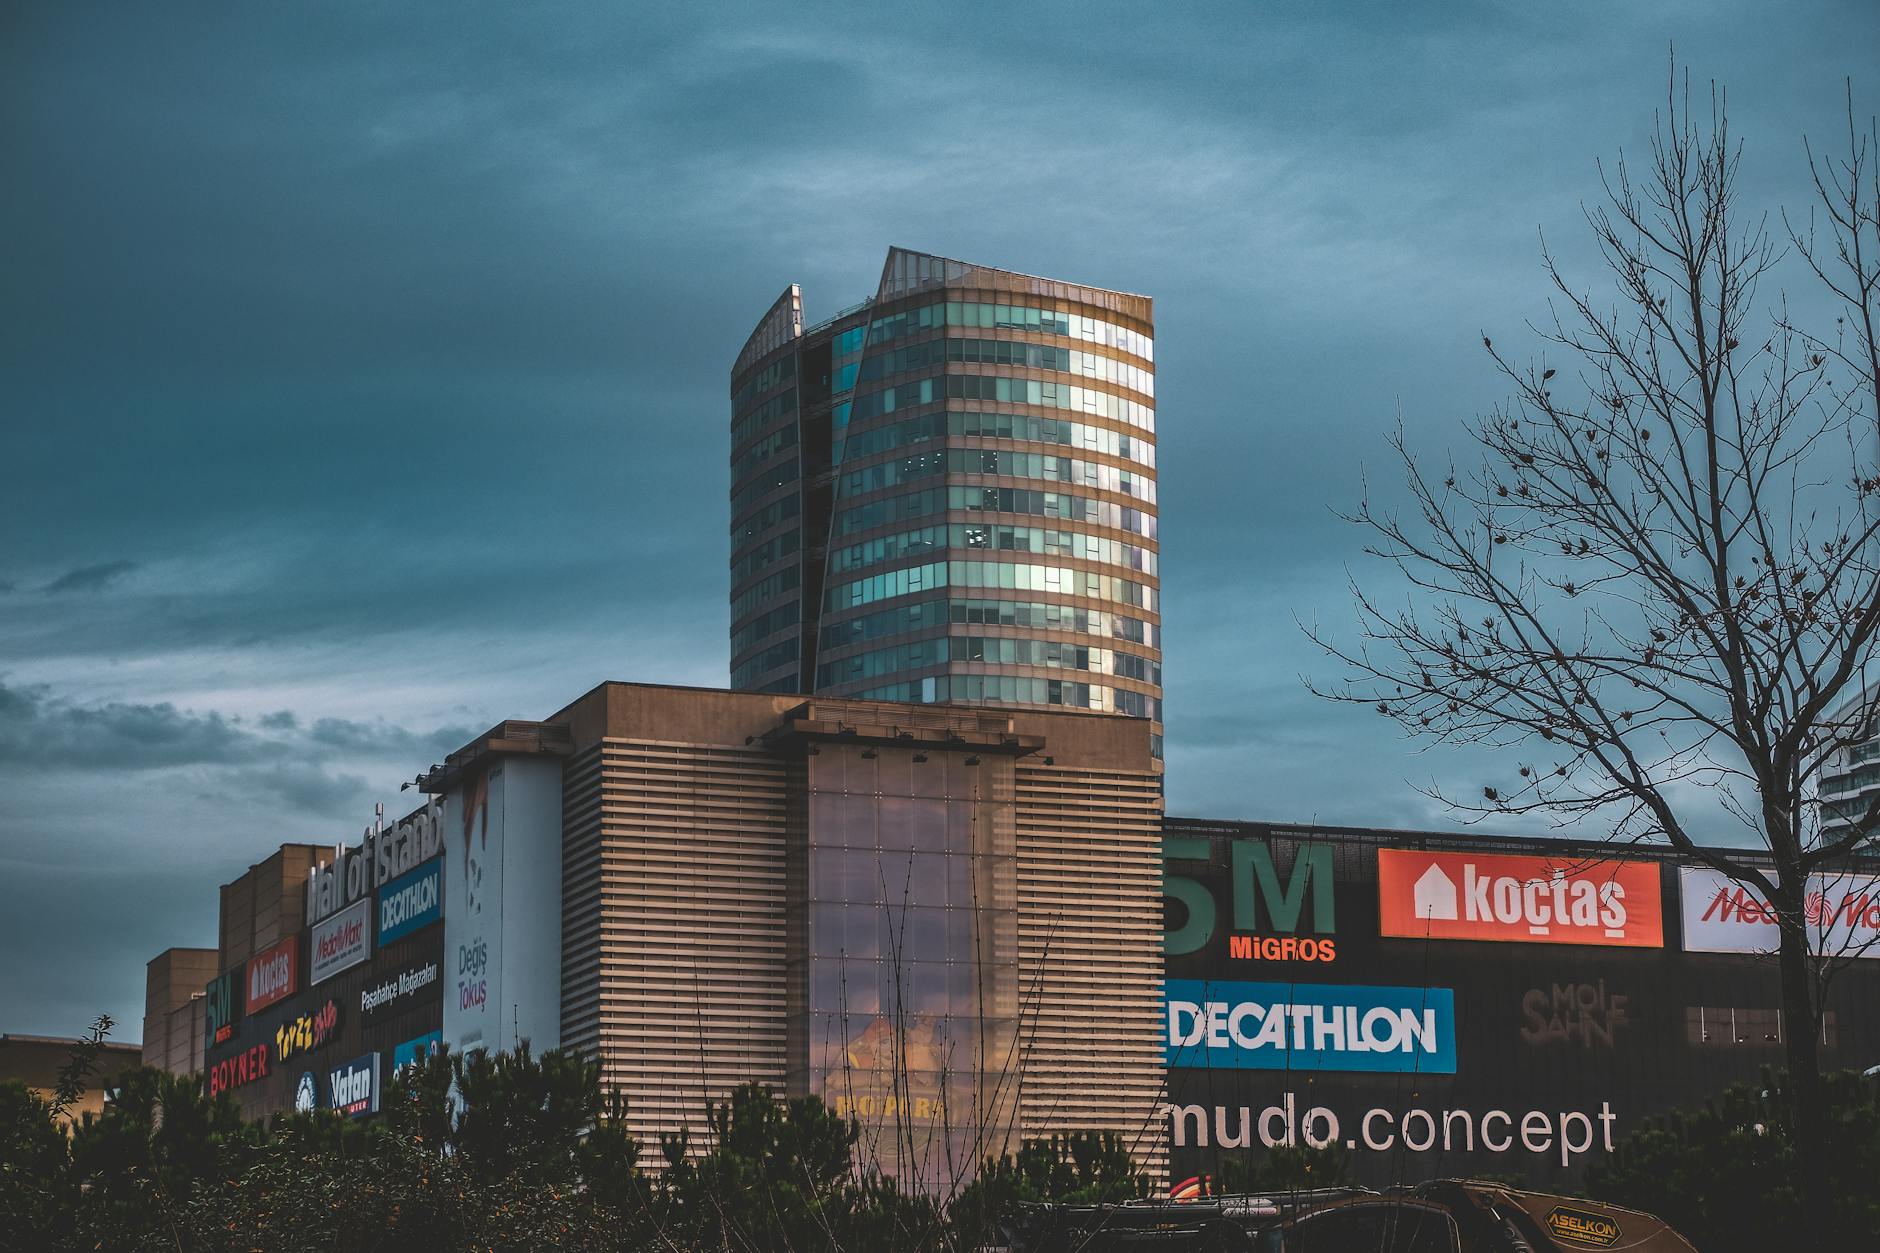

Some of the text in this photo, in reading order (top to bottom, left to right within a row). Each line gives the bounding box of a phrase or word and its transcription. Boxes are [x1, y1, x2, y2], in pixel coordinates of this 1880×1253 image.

[347, 826, 375, 902] of
[374, 795, 448, 888] İstanb
[382, 873, 438, 932] DECATHLON
[1463, 863, 1627, 939] koçtaş
[259, 953, 289, 999] koçtaş
[459, 936, 487, 977] Değiş
[361, 981, 398, 1015] Paşabahçe
[458, 979, 487, 1013] Tokuş
[1167, 1001, 1437, 1054] DECATHLON
[210, 1044, 268, 1096] BOYNER
[330, 1065, 370, 1110] Vatan
[1160, 1092, 1618, 1167] mudo.concept
[1549, 1214, 1617, 1235] ASELKON
